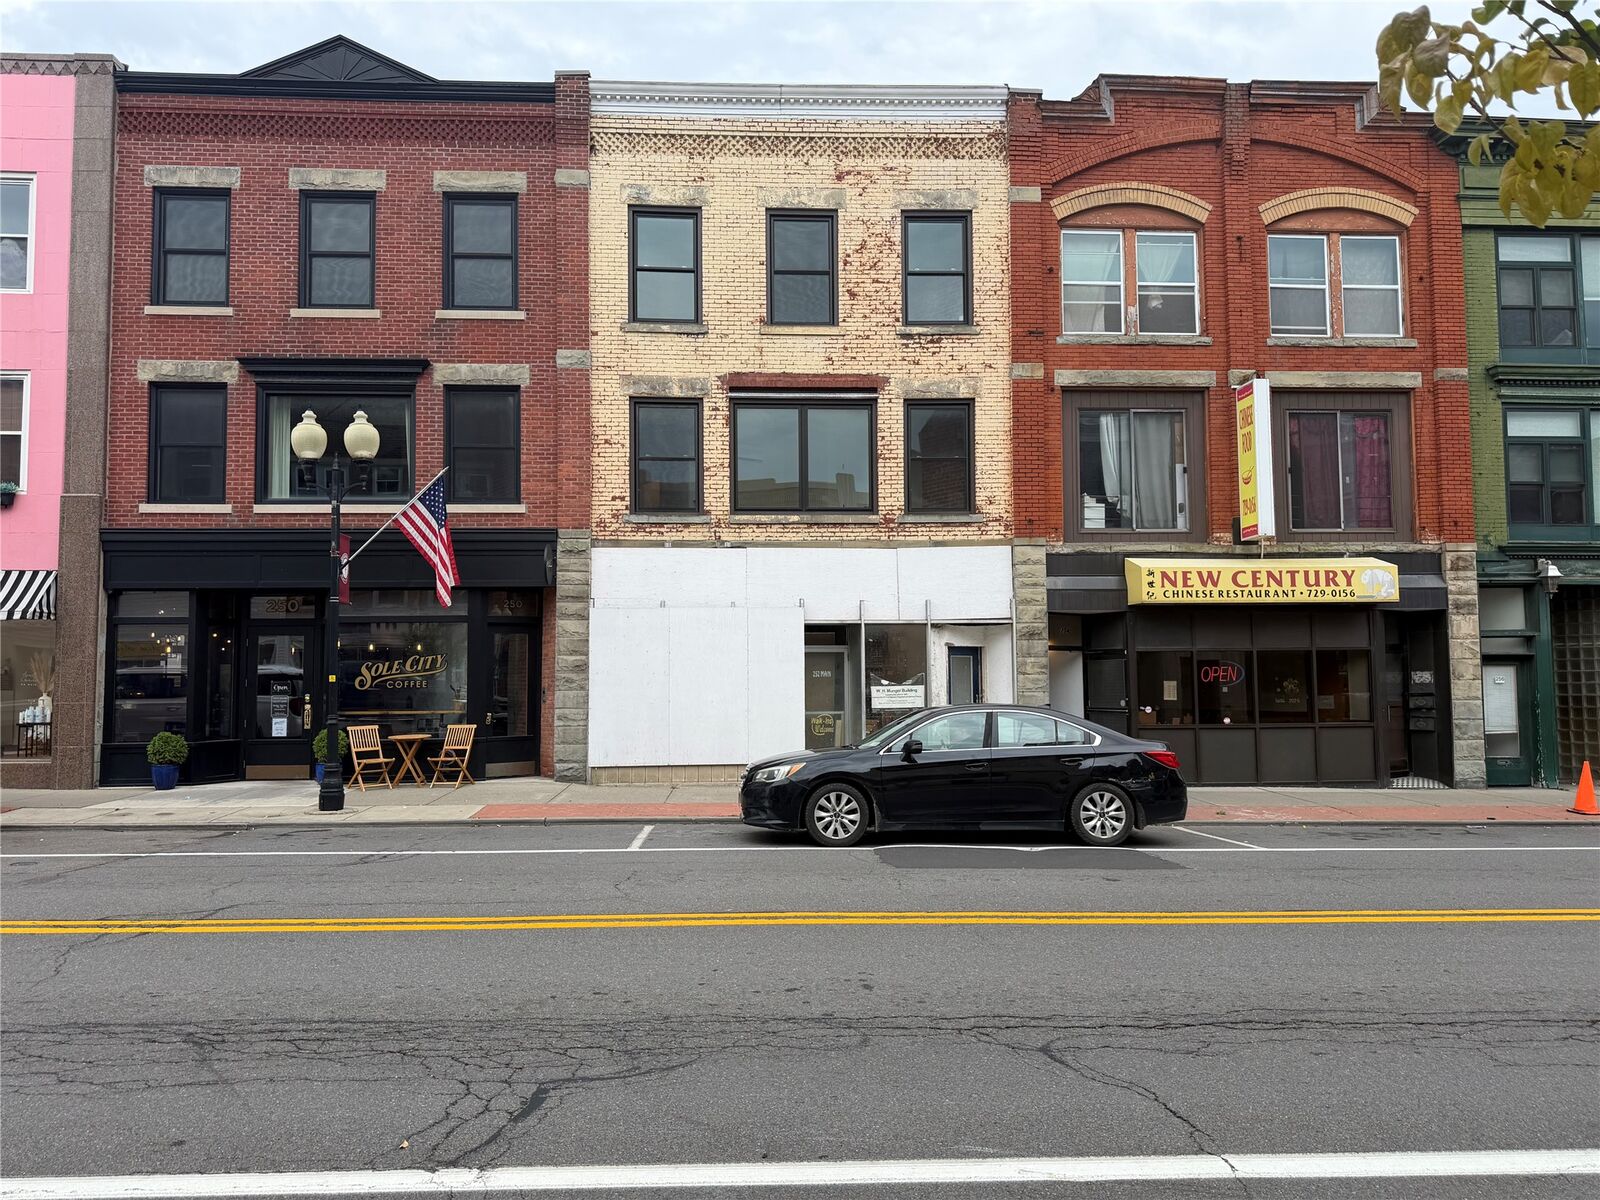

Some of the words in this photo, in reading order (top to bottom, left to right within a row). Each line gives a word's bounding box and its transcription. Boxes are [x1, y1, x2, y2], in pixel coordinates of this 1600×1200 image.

[1160, 570, 1222, 588] NEW
[1231, 569, 1356, 588] CENTURY
[1163, 589, 1215, 598] CHINESE
[1218, 589, 1297, 598] RESTAURANT
[1306, 589, 1356, 598] 729-0156
[265, 599, 300, 613] 250
[503, 599, 523, 608] 250
[1201, 666, 1237, 682] OPEN
[386, 680, 428, 689] COFFEE
